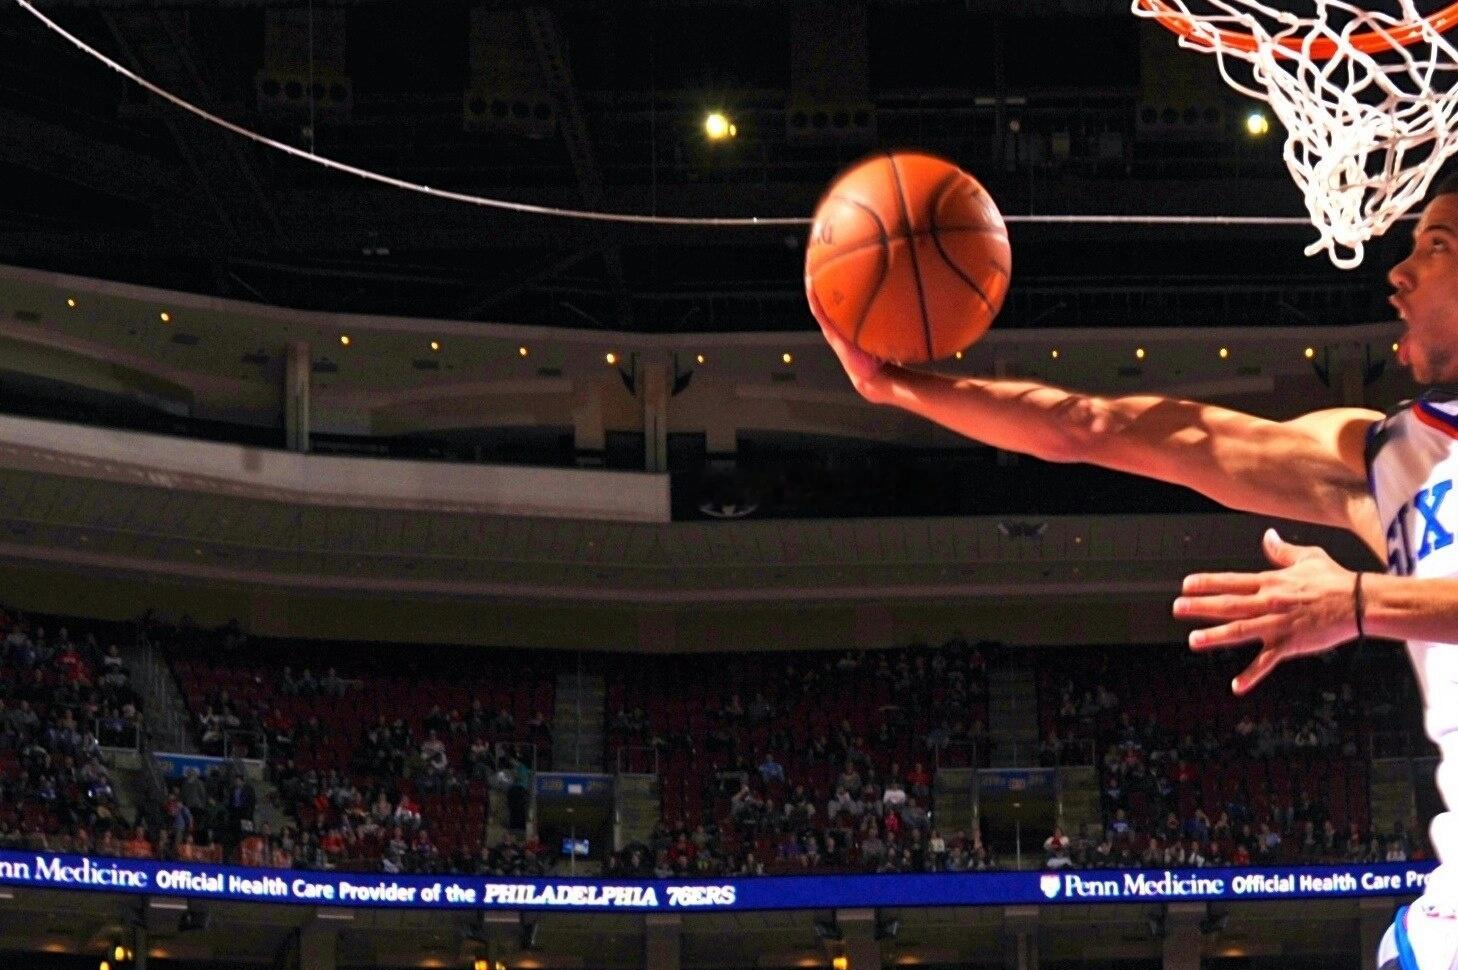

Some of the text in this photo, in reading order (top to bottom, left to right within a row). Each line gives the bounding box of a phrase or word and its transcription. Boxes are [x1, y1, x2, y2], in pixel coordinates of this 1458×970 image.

[35, 856, 148, 888] Medicine
[156, 869, 224, 893] Official
[229, 874, 288, 897] Health
[292, 879, 335, 900] Care
[339, 881, 416, 903] Provider
[420, 883, 442, 903] of
[445, 884, 476, 904] the
[484, 884, 659, 907] PHILADELPHIA
[666, 886, 736, 907] 76ERS
[1065, 874, 1120, 897] Penn
[1123, 870, 1225, 896] Medicine
[1232, 874, 1295, 895] Official
[1299, 872, 1357, 892] Health
[1361, 871, 1401, 890] Care
